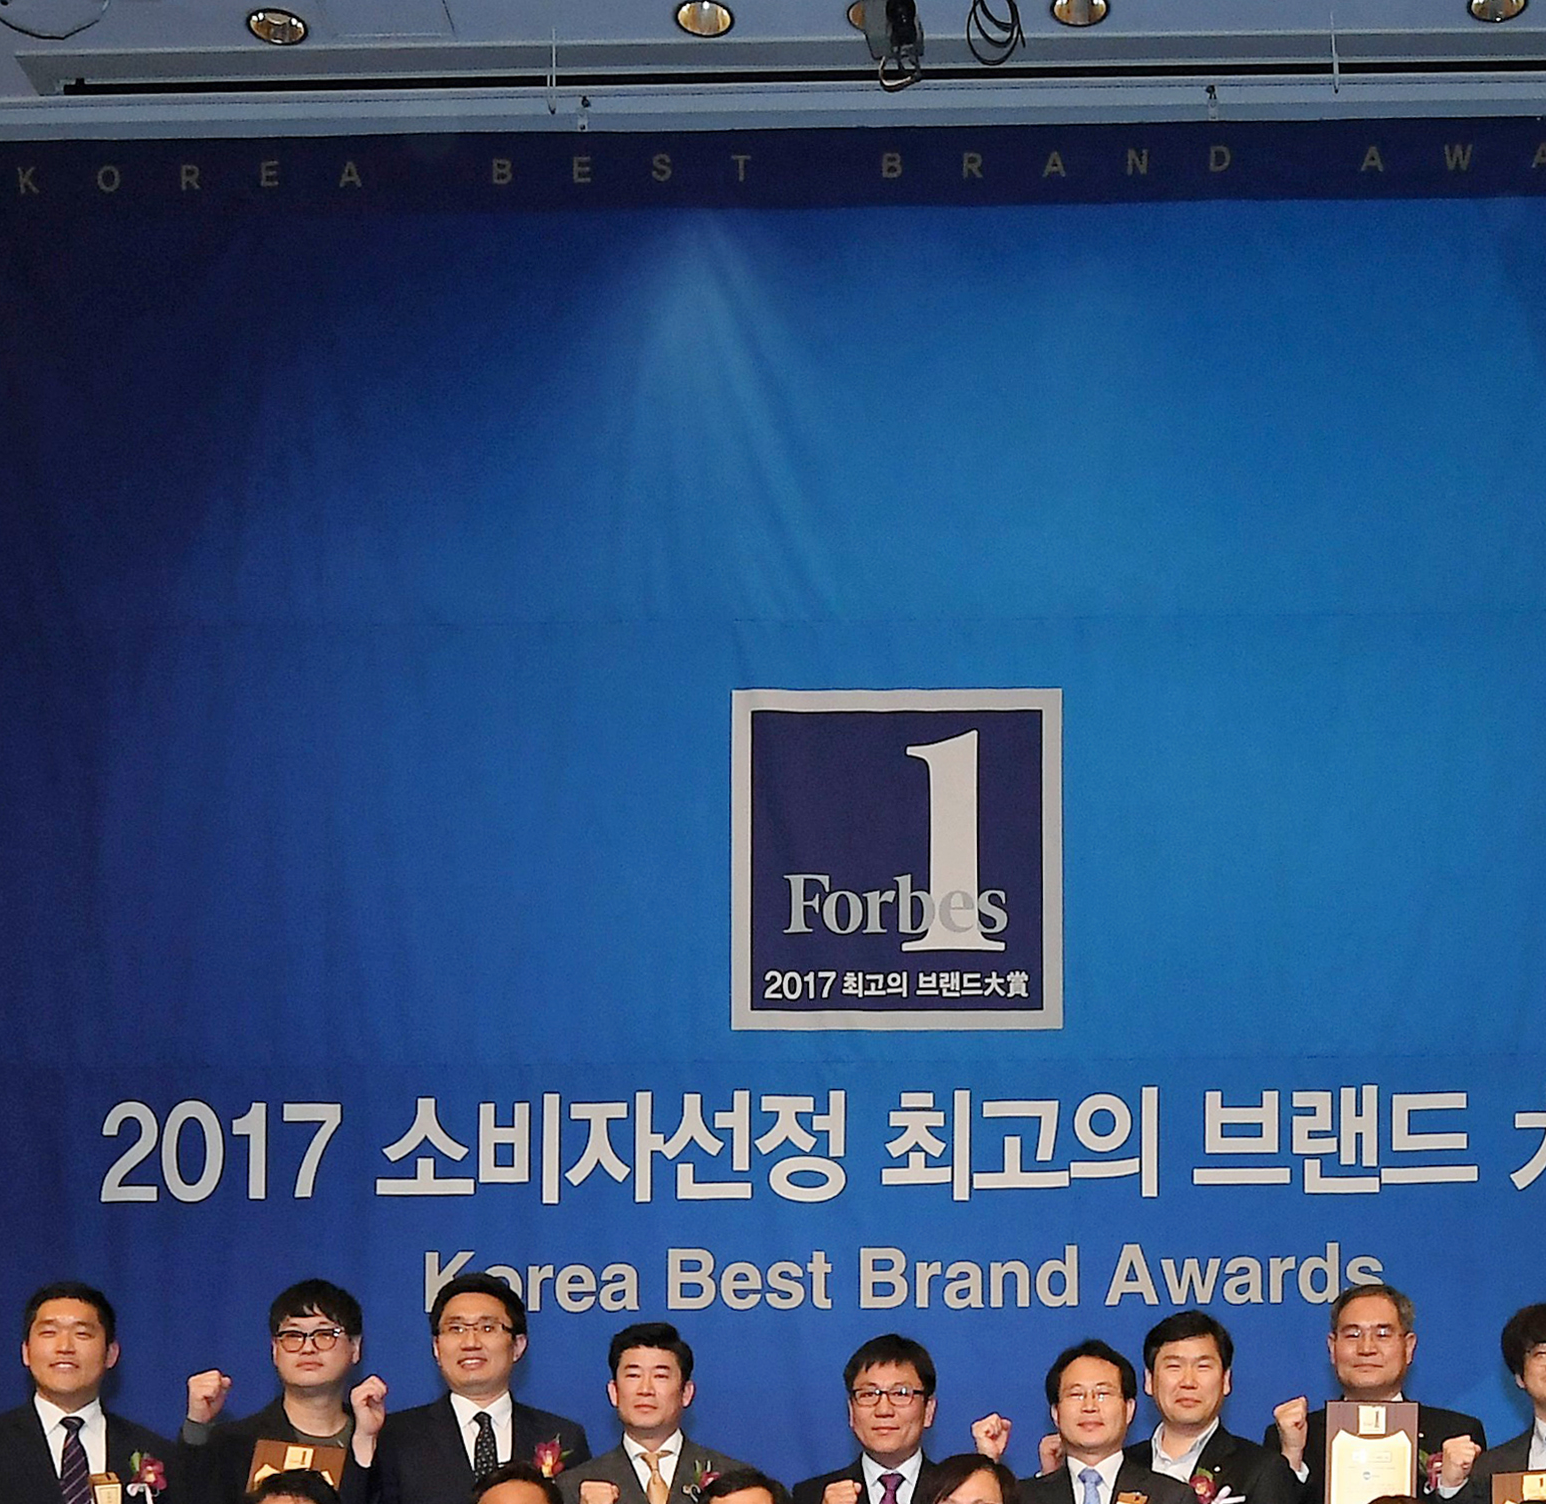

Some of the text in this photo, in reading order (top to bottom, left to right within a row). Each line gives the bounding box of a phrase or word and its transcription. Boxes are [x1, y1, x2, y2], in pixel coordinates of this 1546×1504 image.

[17, 159, 362, 195] KOREA
[491, 152, 752, 186] BEST
[881, 144, 1233, 181] BRAND
[901, 728, 1006, 951] 1
[782, 873, 1009, 935] Forbes
[763, 970, 1030, 1000] 2017 최고의 브랜드大賞
[100, 1098, 342, 1203] 2017
[375, 1089, 847, 1204] 소비자선정
[880, 1085, 1159, 1201] 최고의
[1192, 1083, 1480, 1194] 브랜드
[665, 1247, 833, 1311] Best
[858, 1244, 1079, 1310] Brand
[1105, 1241, 1385, 1307] Awards
